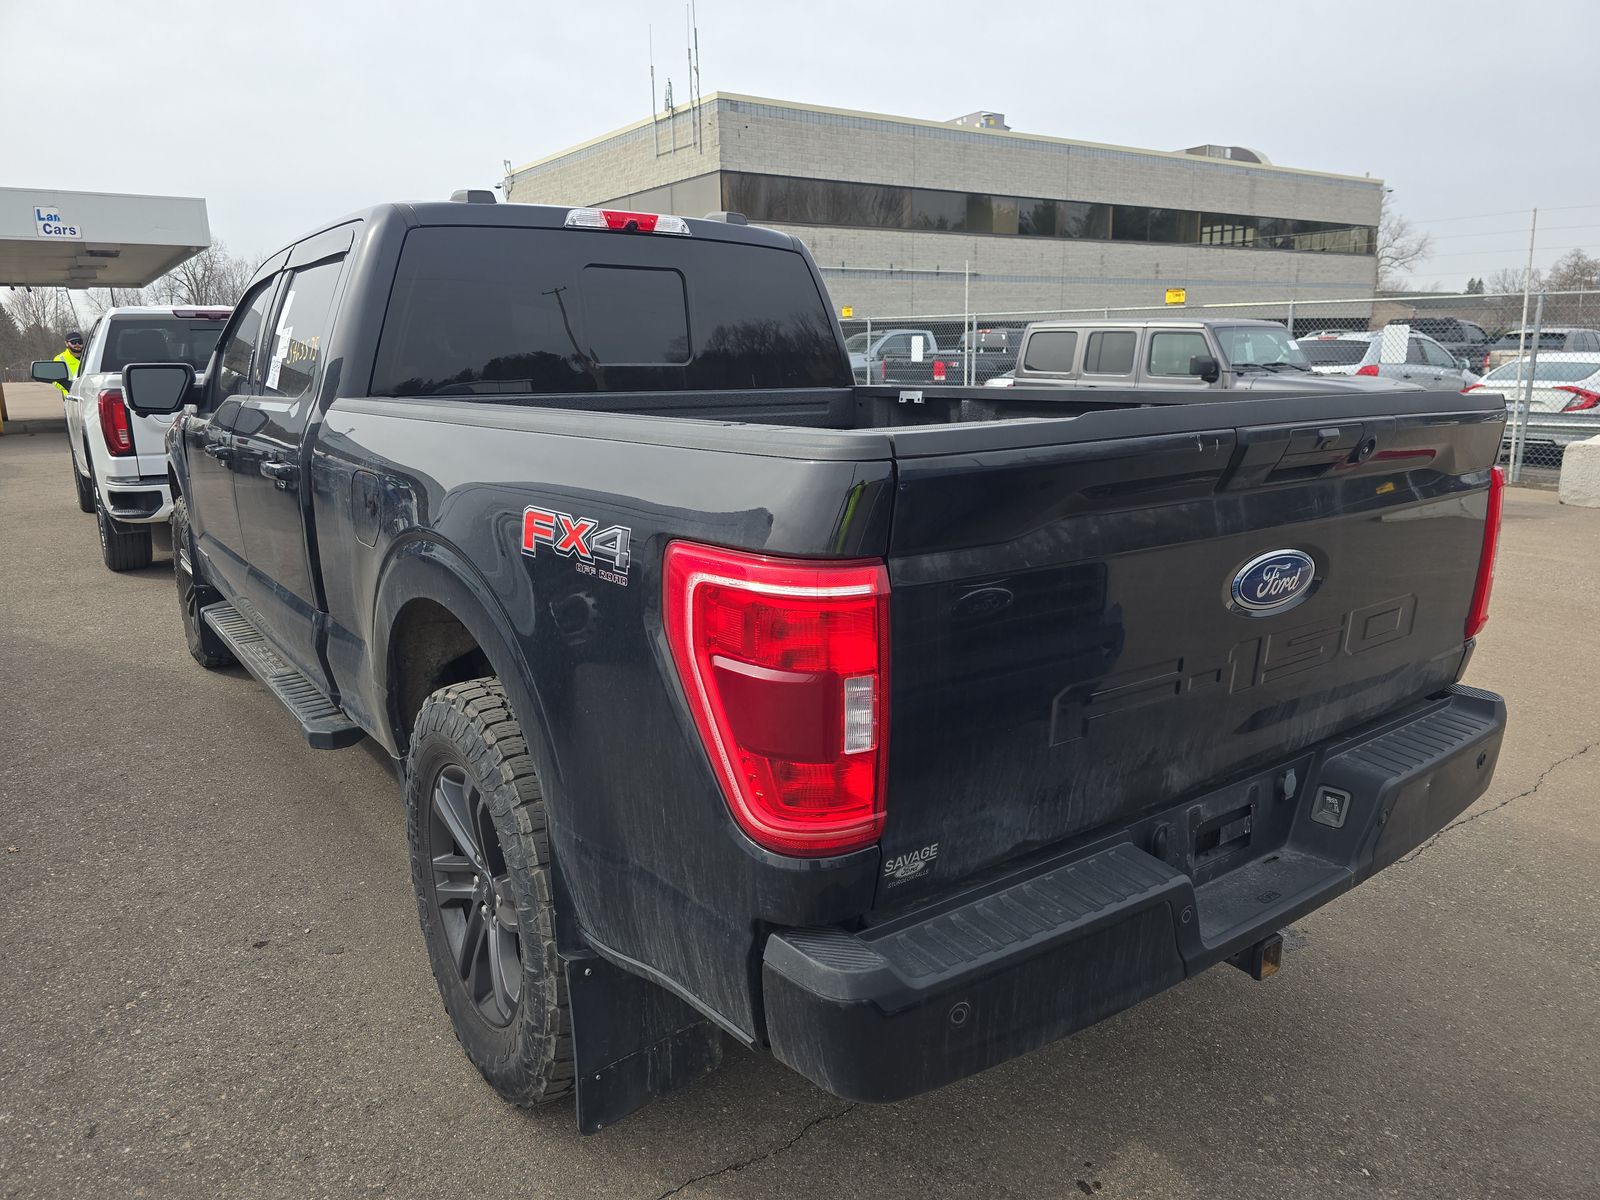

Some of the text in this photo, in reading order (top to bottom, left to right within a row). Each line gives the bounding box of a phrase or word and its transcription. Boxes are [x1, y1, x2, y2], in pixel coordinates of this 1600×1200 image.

[42, 223, 77, 236] Cars
[521, 505, 632, 575] FX4
[576, 563, 628, 586] OFF ROAD
[1256, 562, 1302, 599] Ford
[1049, 593, 1419, 748] F-150
[884, 843, 939, 873] SAVAGE
